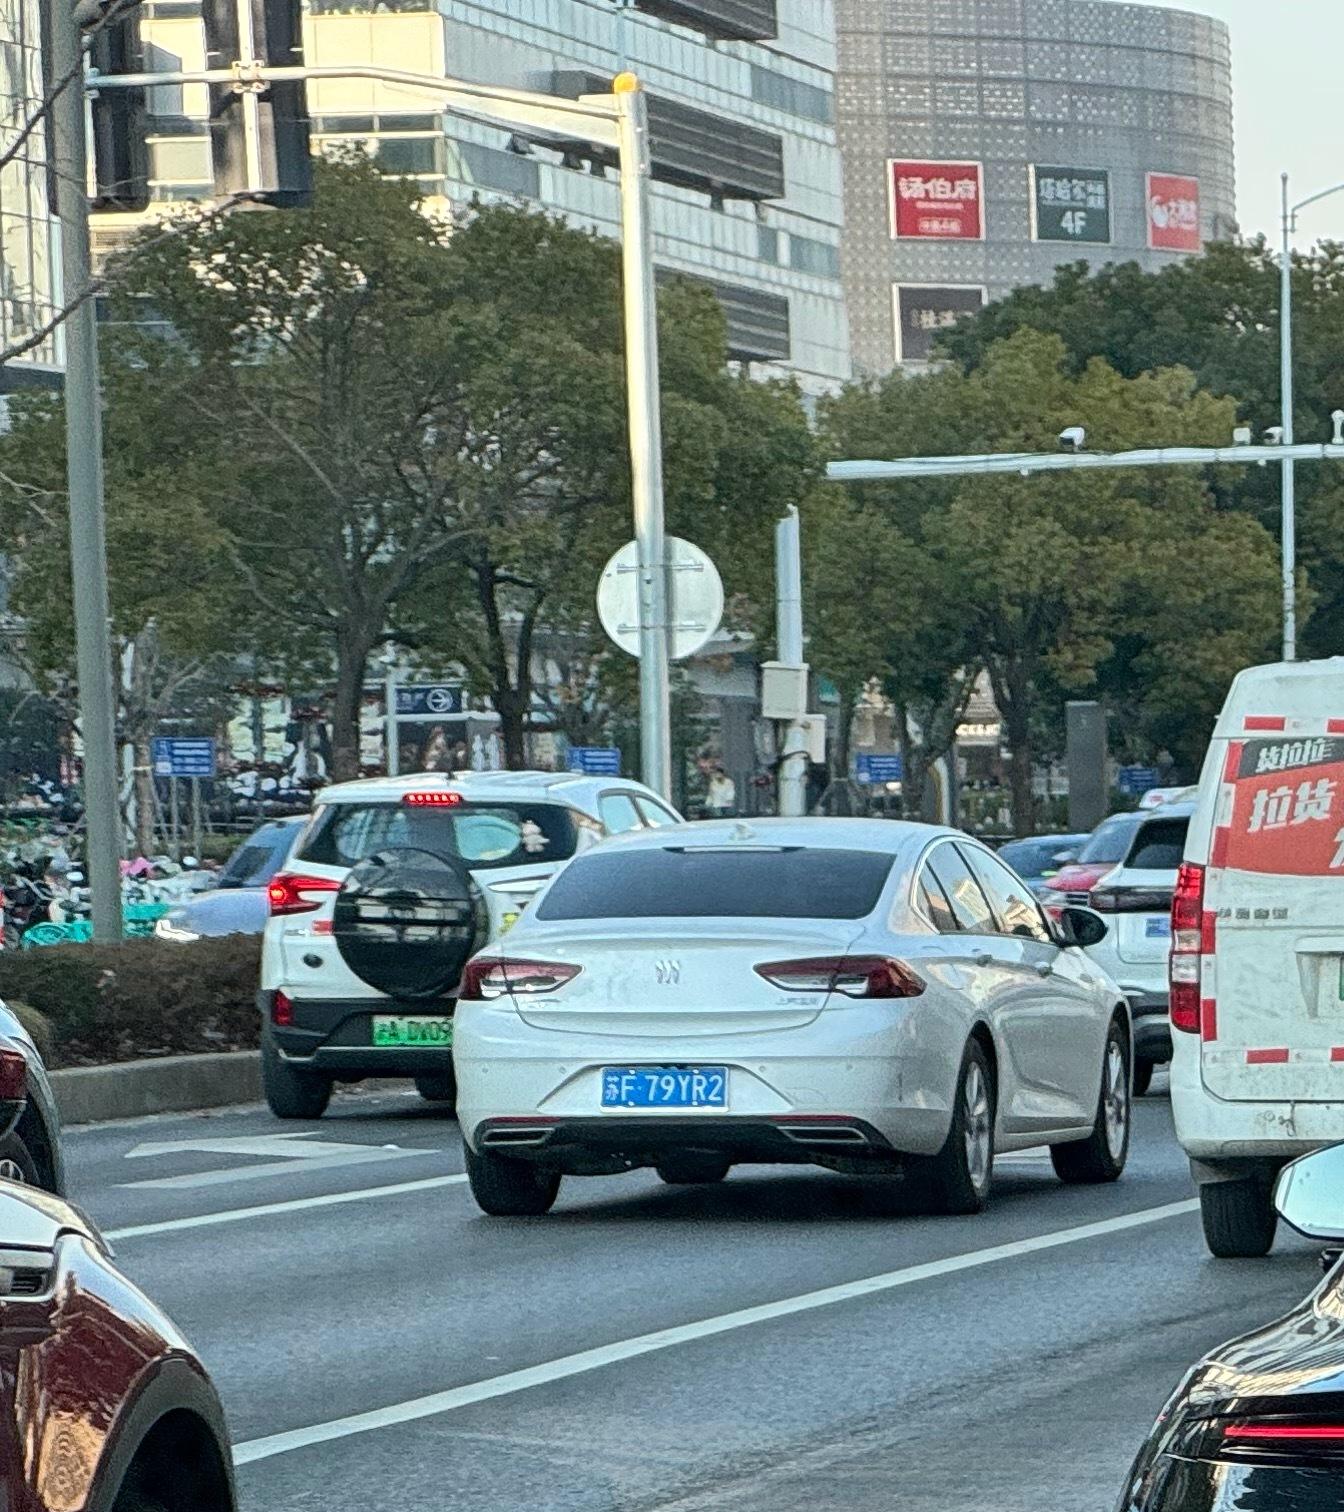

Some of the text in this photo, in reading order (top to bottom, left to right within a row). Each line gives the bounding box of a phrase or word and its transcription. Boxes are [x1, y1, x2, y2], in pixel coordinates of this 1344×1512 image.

[1060, 211, 1087, 235] 4F
[1257, 739, 1333, 773] 货拉拉
[1247, 778, 1338, 833] 拉货
